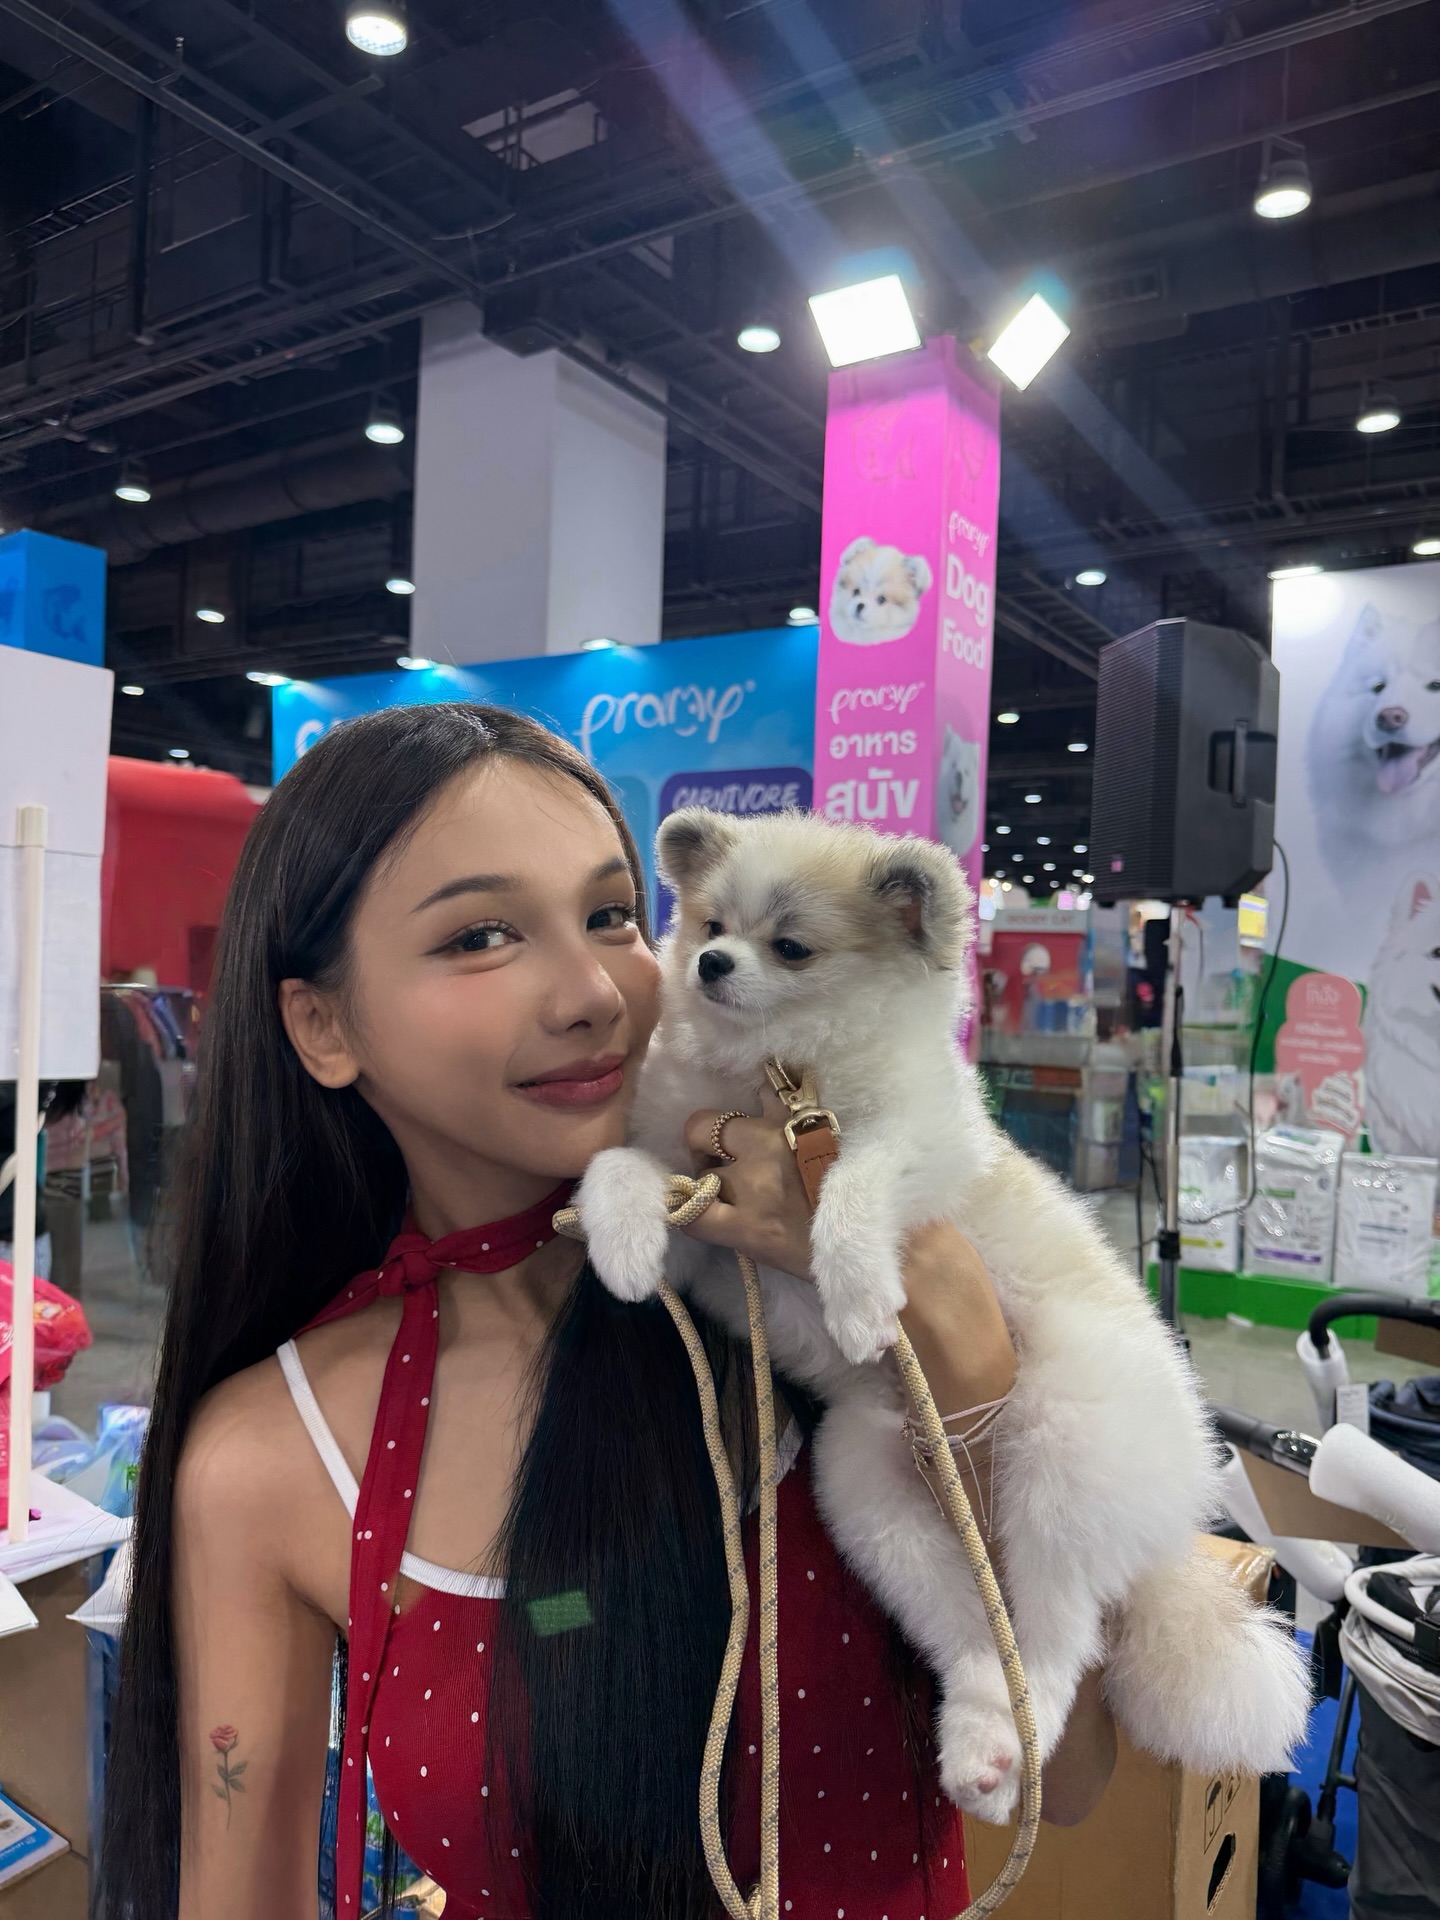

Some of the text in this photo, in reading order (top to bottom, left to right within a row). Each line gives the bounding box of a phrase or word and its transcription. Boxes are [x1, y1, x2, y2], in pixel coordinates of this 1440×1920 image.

[947, 553, 988, 628] Dog
[943, 616, 986, 670] Food
[829, 729, 917, 760] อาหาร
